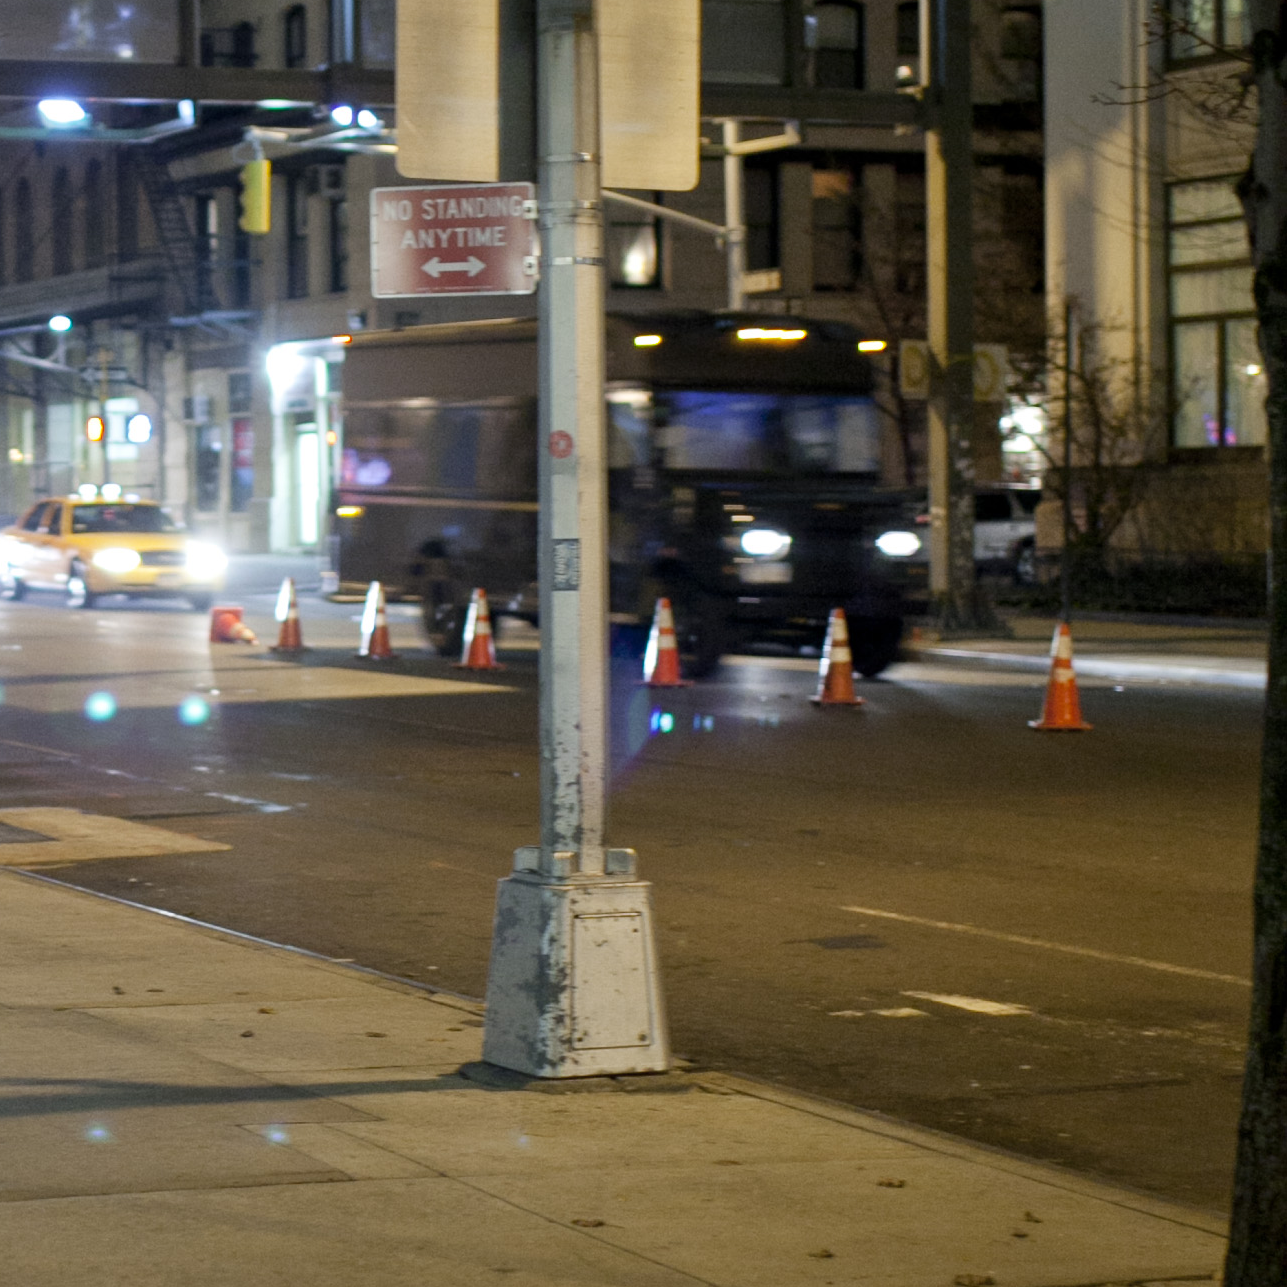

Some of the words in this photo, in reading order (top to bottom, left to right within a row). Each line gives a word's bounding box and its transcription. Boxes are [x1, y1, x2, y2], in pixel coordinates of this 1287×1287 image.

[382, 200, 412, 221] NO
[421, 195, 524, 221] STANDING
[400, 226, 506, 250] ANYTIME
